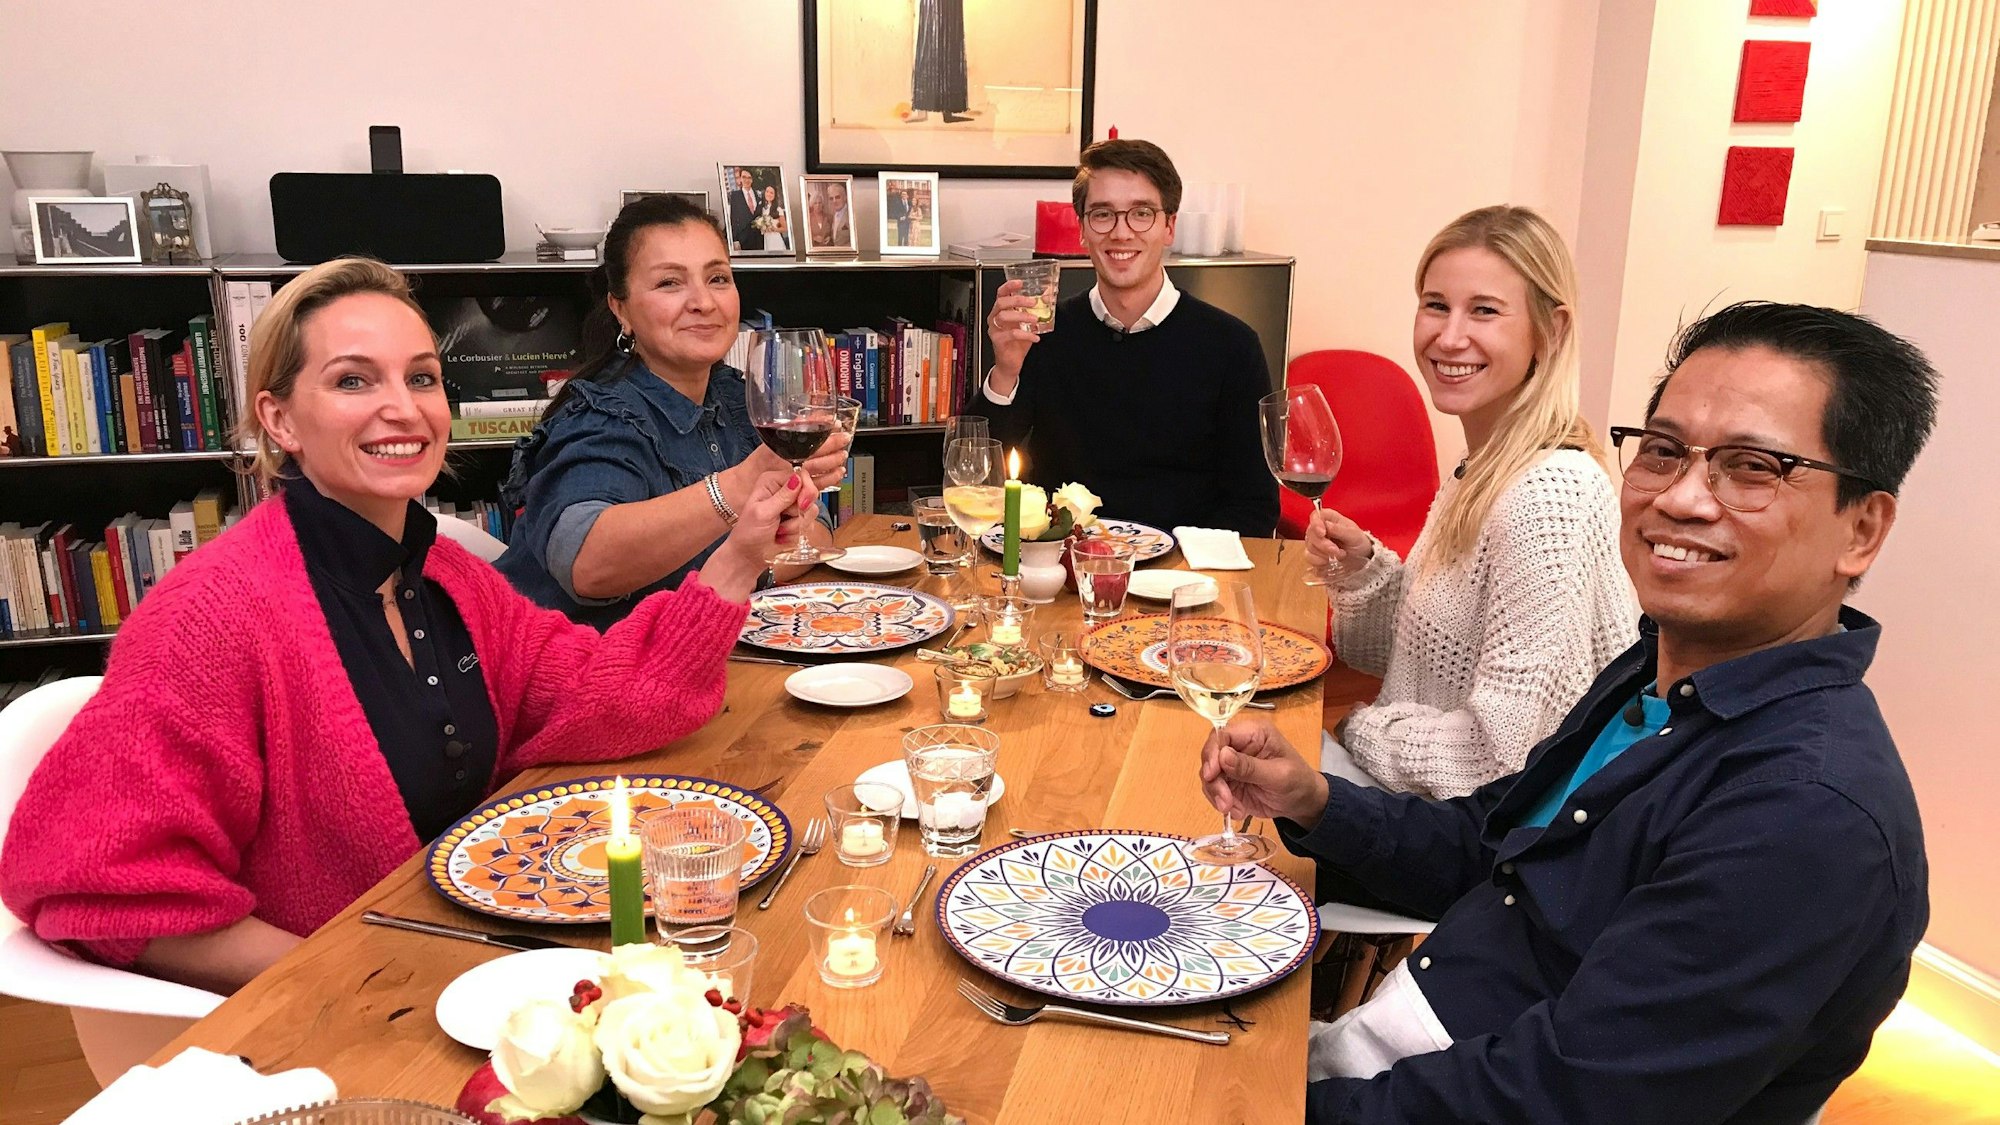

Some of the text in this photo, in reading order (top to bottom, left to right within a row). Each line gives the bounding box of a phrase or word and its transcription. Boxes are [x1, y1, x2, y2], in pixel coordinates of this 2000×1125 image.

[195, 332, 204, 347] GLOBAL
[196, 348, 206, 368] PROPERTY
[209, 329, 222, 378] Ruinen-Jahre
[447, 354, 458, 362] Le
[460, 353, 502, 362] Corbusier
[512, 352, 540, 361] Lucien
[542, 352, 567, 360] Hervé
[199, 368, 209, 395] INVESTMENT
[840, 350, 850, 390] MAROKKO
[853, 353, 864, 389] England
[468, 420, 533, 434] TUSCAN
